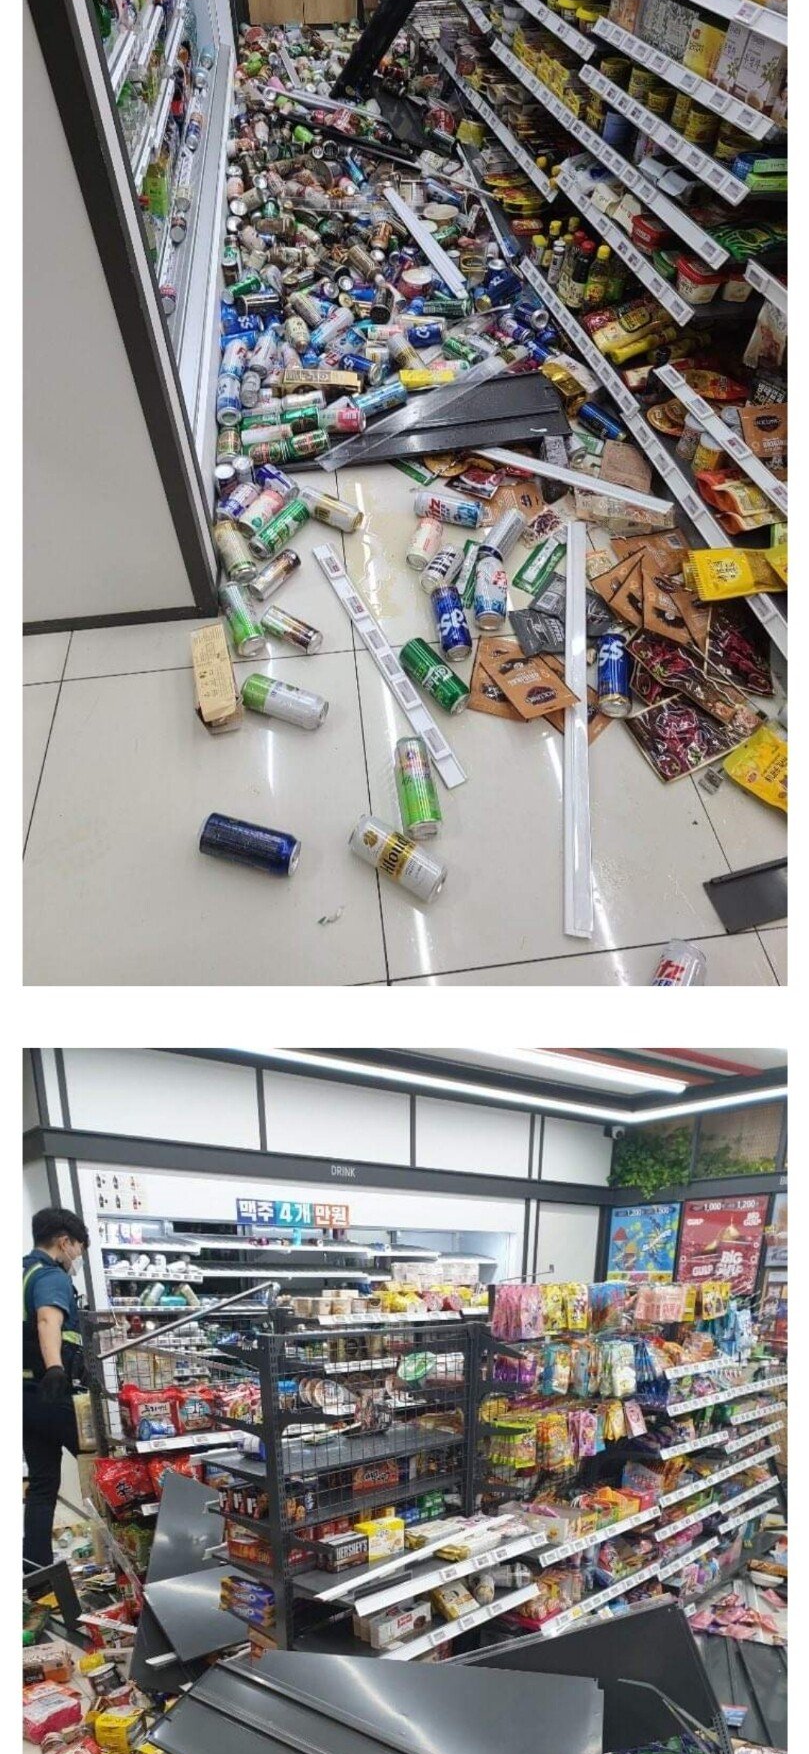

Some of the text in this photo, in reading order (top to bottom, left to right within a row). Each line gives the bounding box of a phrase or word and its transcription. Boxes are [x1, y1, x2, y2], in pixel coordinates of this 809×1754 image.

[331, 1164, 356, 1178] DRINK
[238, 1199, 350, 1227] 맥주 4개 만원
[720, 1250, 743, 1266] BIG
[335, 1542, 369, 1563] HERSHEY'S
